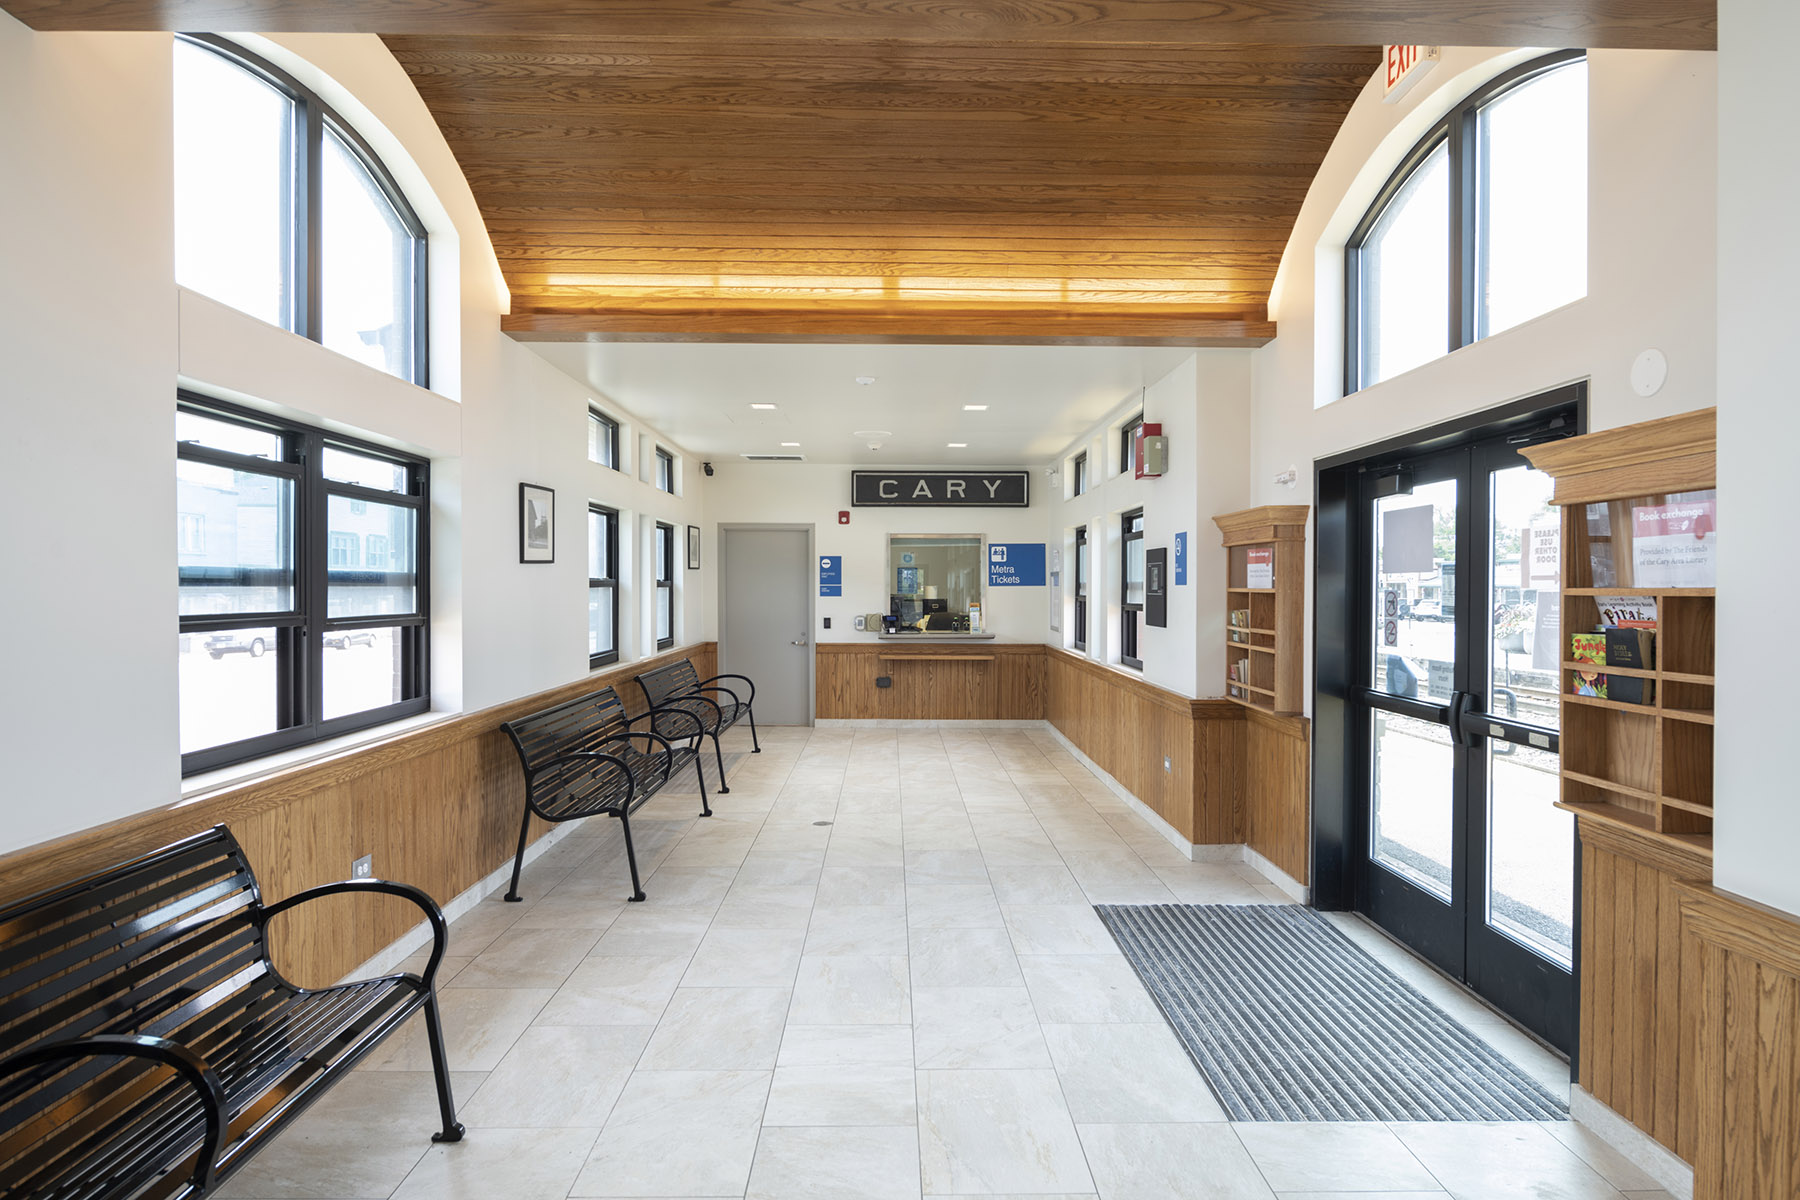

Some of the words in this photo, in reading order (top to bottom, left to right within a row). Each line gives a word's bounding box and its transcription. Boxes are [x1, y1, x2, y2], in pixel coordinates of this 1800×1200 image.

[879, 479, 1001, 498] CARY
[1640, 511, 1660, 521] Book
[1661, 508, 1703, 519] exchange
[991, 565, 1015, 574] Metra
[991, 575, 1020, 584] Tickets
